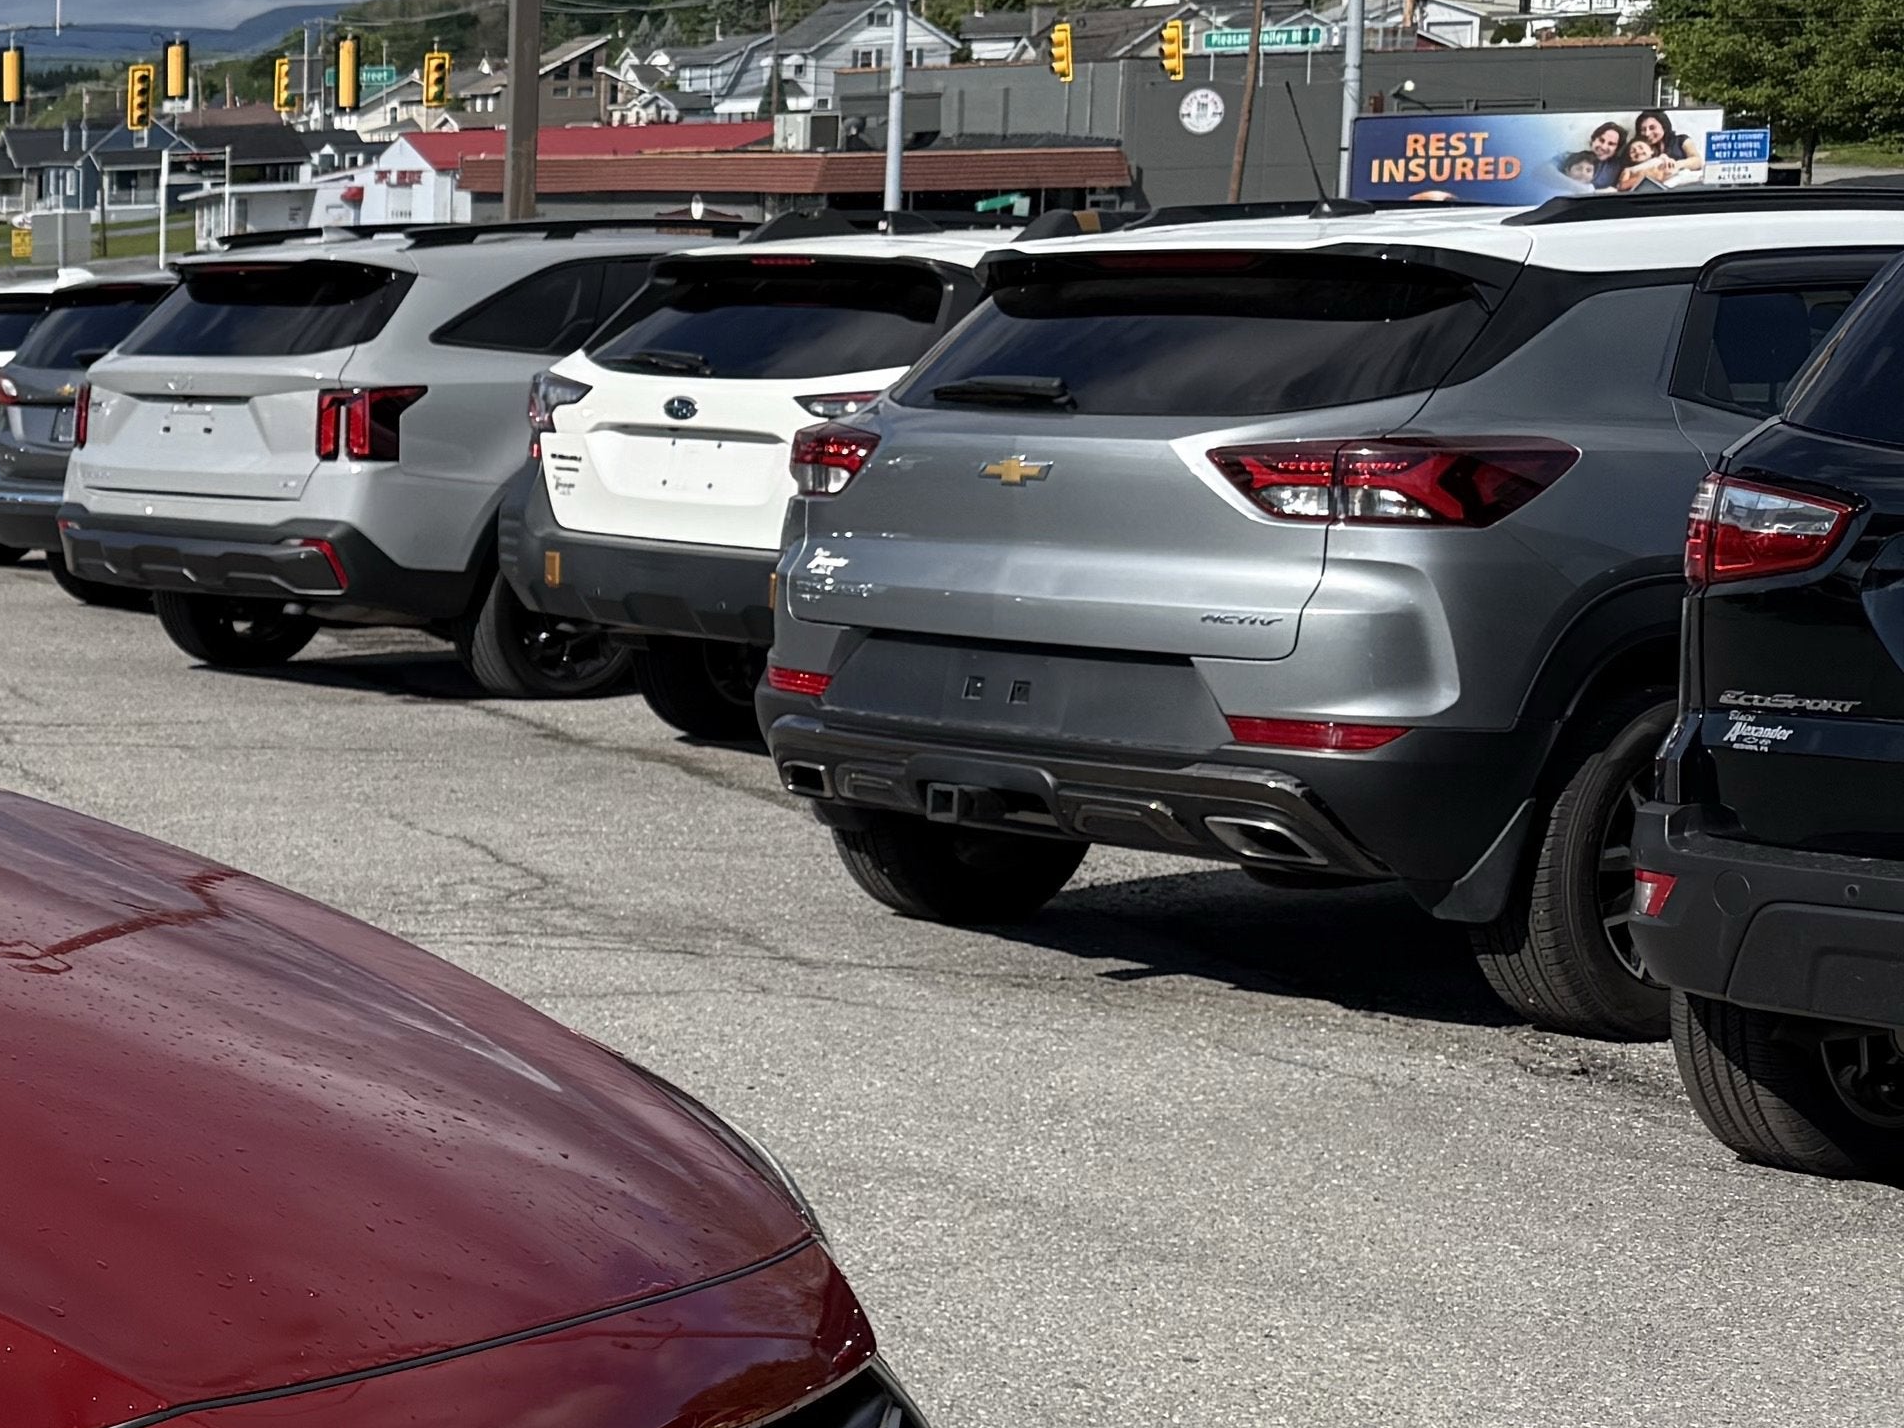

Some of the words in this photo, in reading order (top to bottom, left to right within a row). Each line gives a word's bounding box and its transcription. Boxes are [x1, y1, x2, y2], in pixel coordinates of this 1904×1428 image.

[1211, 33, 1251, 46] Pleasan
[1259, 31, 1288, 46] alley
[361, 70, 388, 82] treet
[1405, 131, 1489, 158] REST
[1370, 156, 1522, 184] INSURED
[1722, 722, 1794, 742] Alexander
